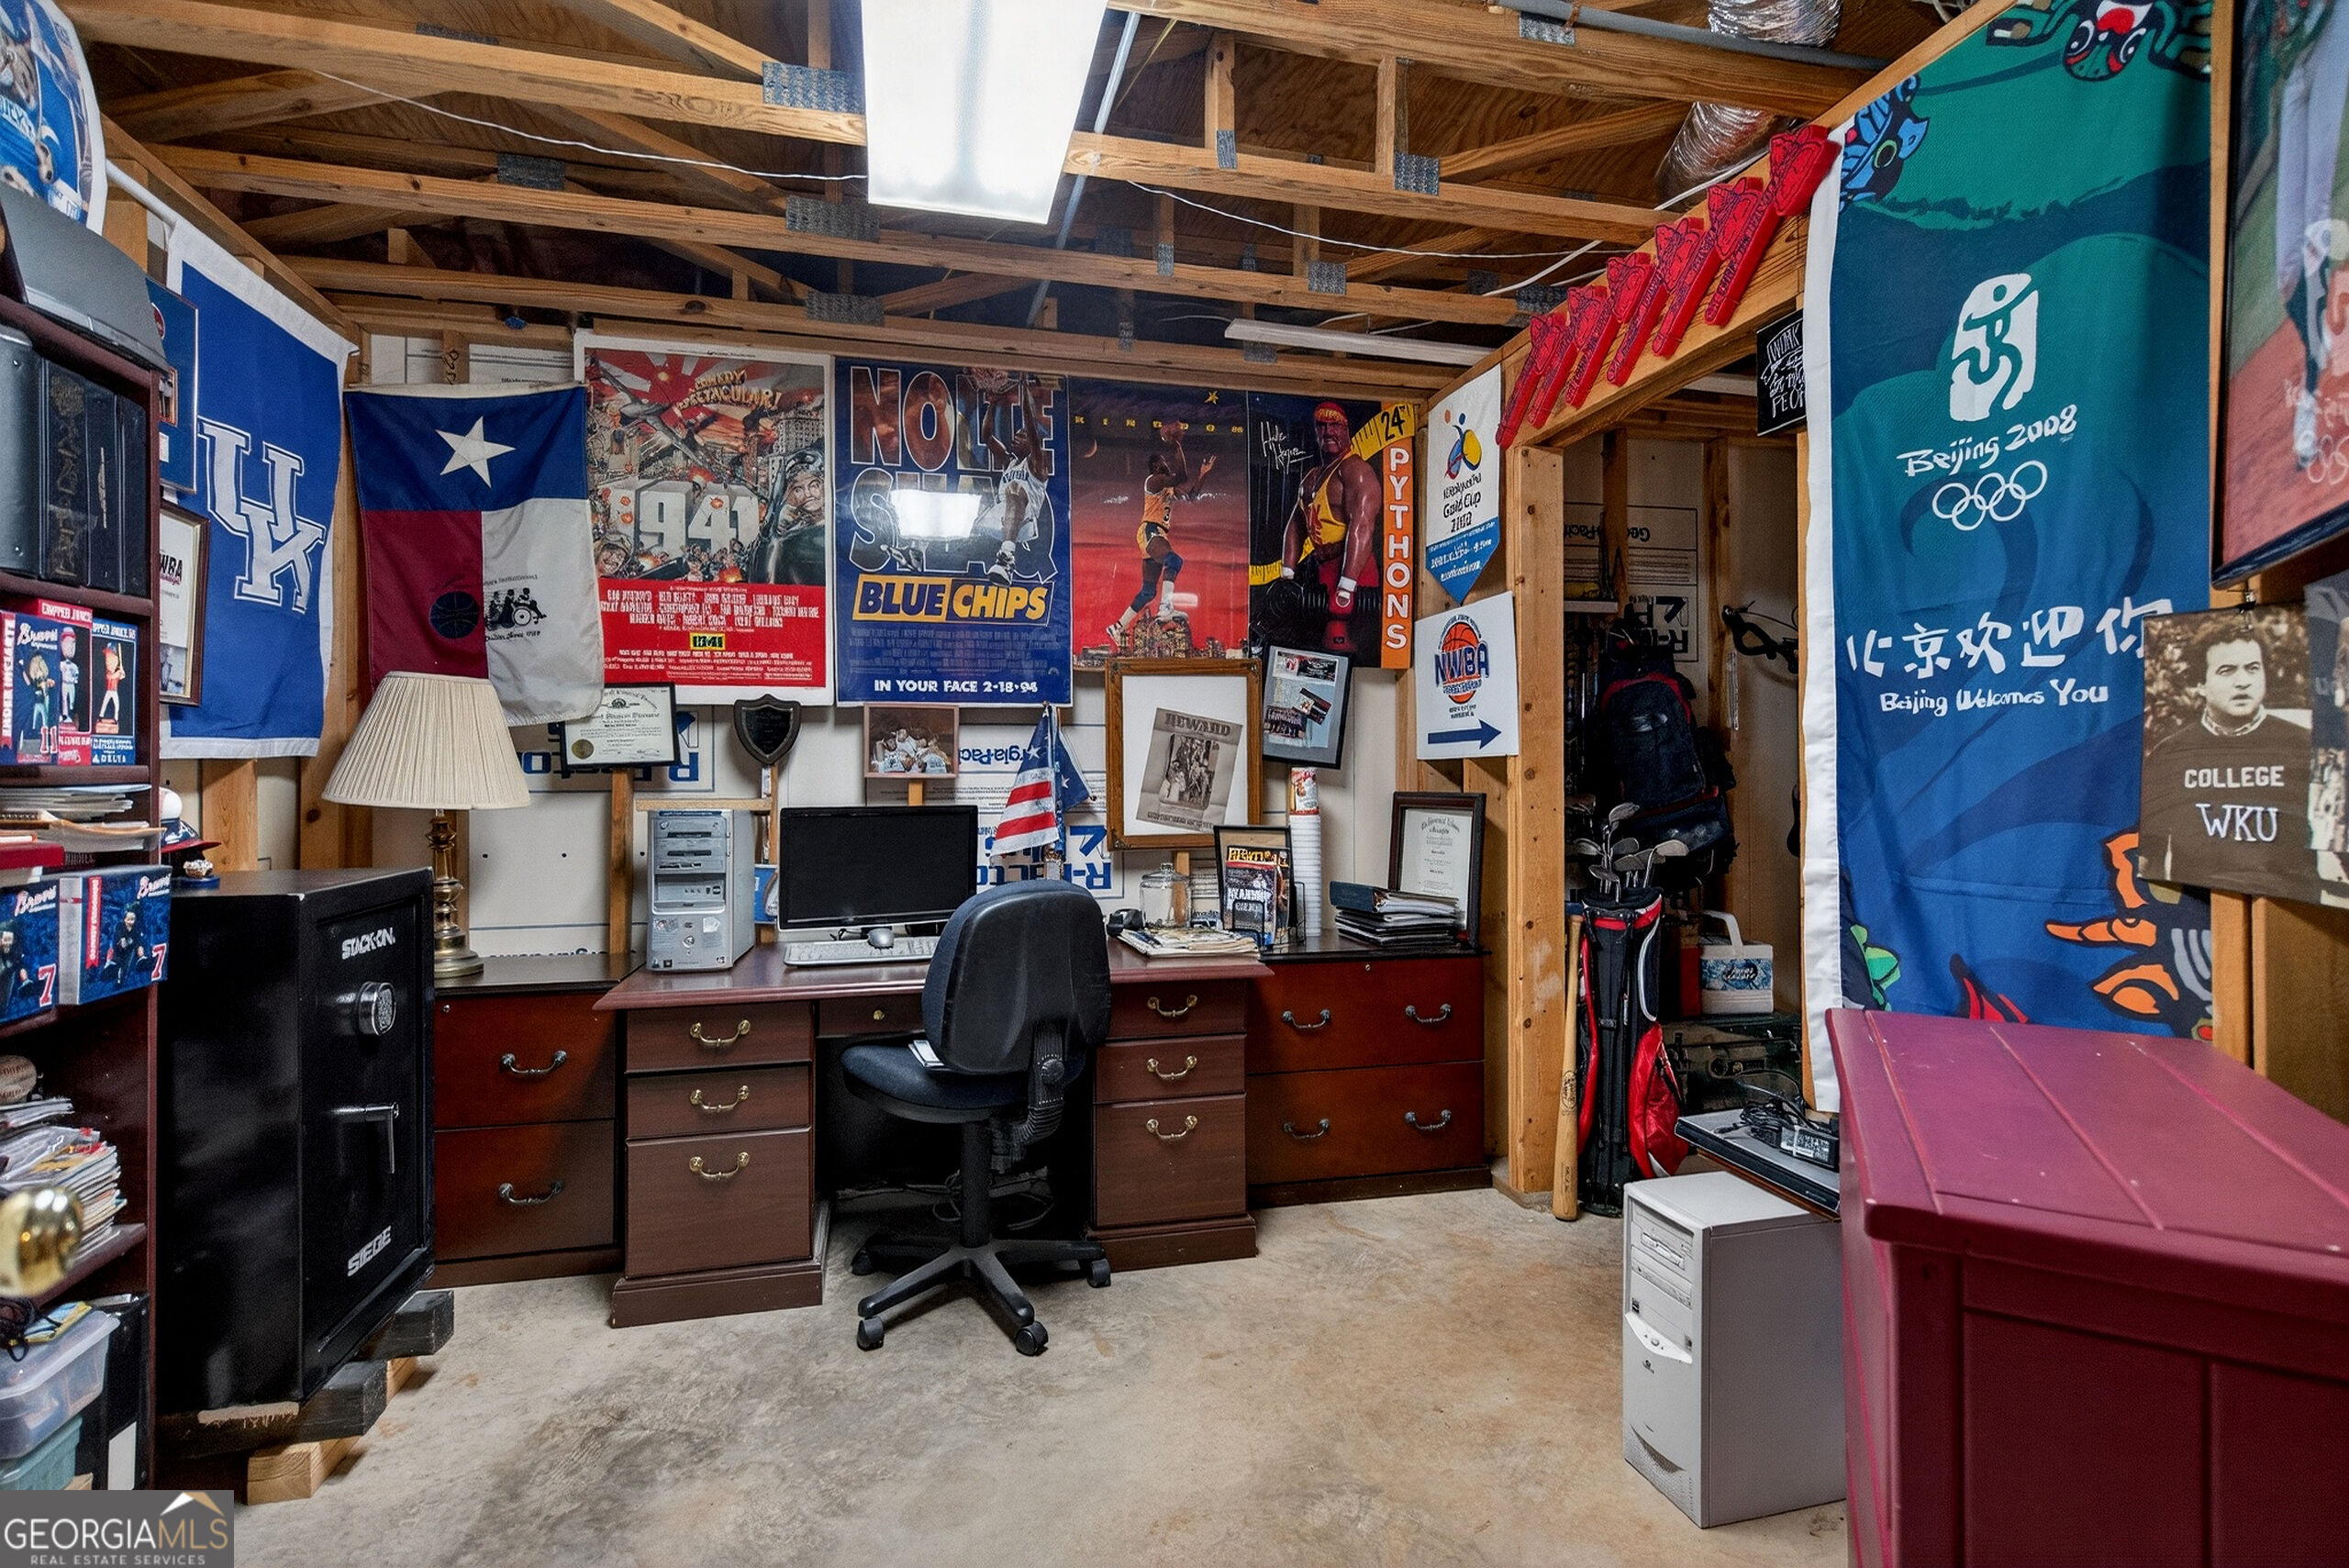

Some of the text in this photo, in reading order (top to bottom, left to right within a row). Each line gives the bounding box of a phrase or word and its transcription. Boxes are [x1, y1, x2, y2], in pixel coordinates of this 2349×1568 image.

[1897, 404, 2077, 477] Beijing 2008
[598, 481, 761, 557] 1941
[1386, 447, 1411, 650] PYTHONS
[858, 581, 947, 616] BLUE
[952, 584, 1049, 621] CHIPS
[874, 679, 892, 692] IN
[896, 679, 938, 693] YOUR
[943, 681, 977, 693] FACE
[1434, 643, 1489, 687] NWBA
[1880, 677, 2109, 717] Beijing Welcomes You
[2184, 765, 2285, 789] COLLEGE
[2196, 804, 2279, 841] WKU
[151, 943, 167, 981] 7
[38, 963, 56, 1007] 7
[347, 1226, 392, 1276] SIEGE
